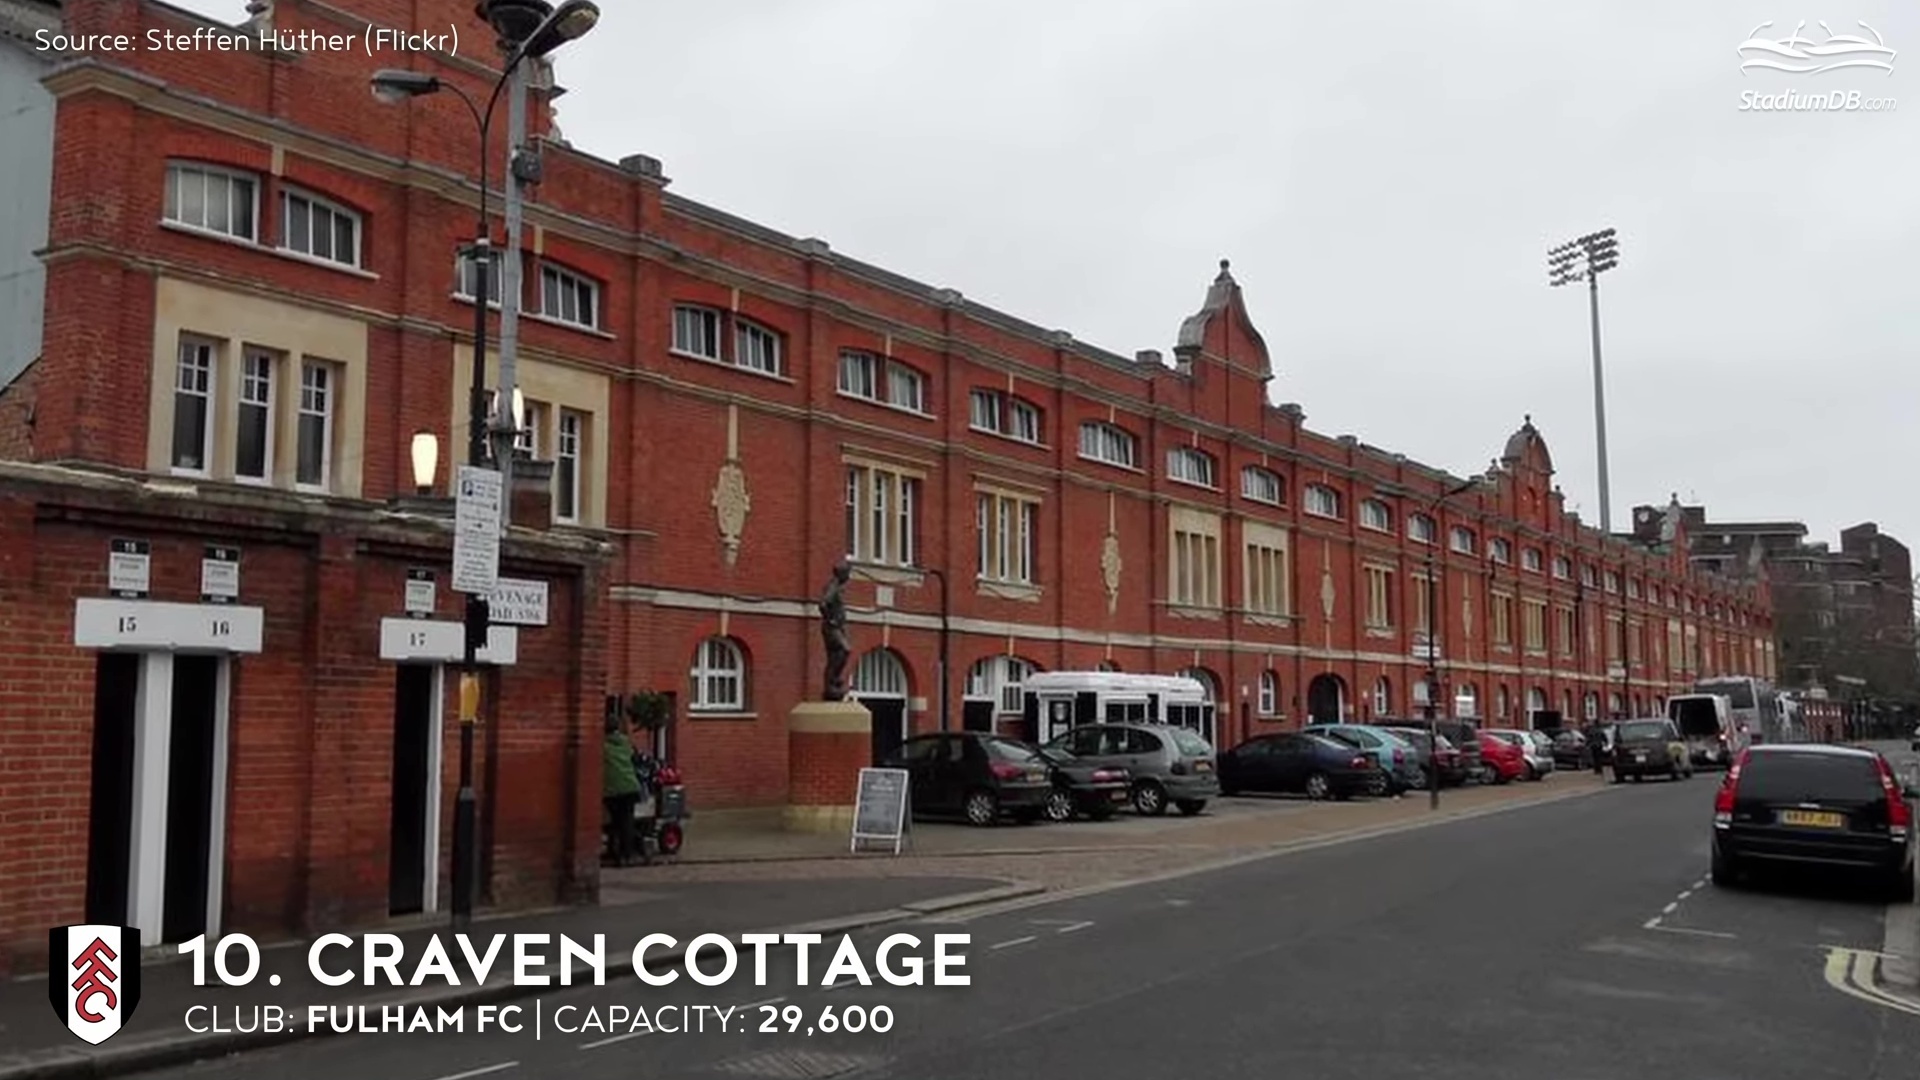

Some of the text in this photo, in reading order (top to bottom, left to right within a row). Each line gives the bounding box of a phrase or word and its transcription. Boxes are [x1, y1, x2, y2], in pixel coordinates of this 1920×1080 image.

[119, 617, 137, 633] 15
[212, 621, 230, 636] 16
[410, 632, 426, 647] 17
